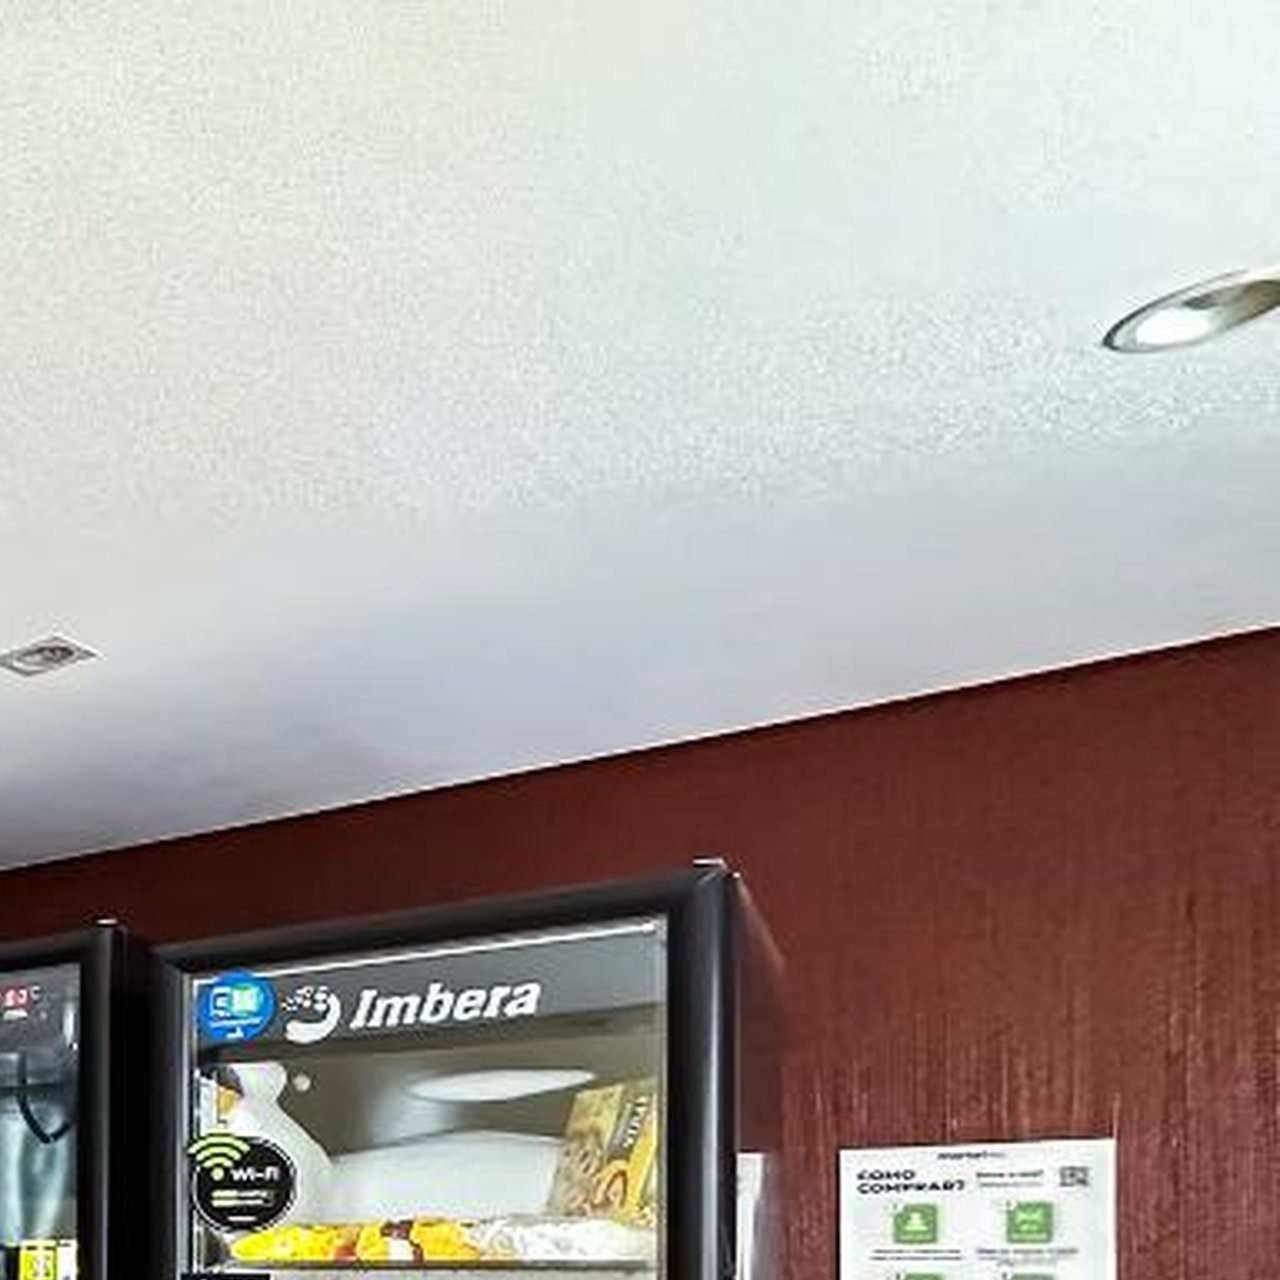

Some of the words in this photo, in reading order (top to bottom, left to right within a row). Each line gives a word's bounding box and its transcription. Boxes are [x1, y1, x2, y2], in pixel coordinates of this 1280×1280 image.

[350, 982, 541, 1030] Imbera
[856, 1169, 917, 1181] COMO
[856, 1180, 966, 1194] COMPRAR?
